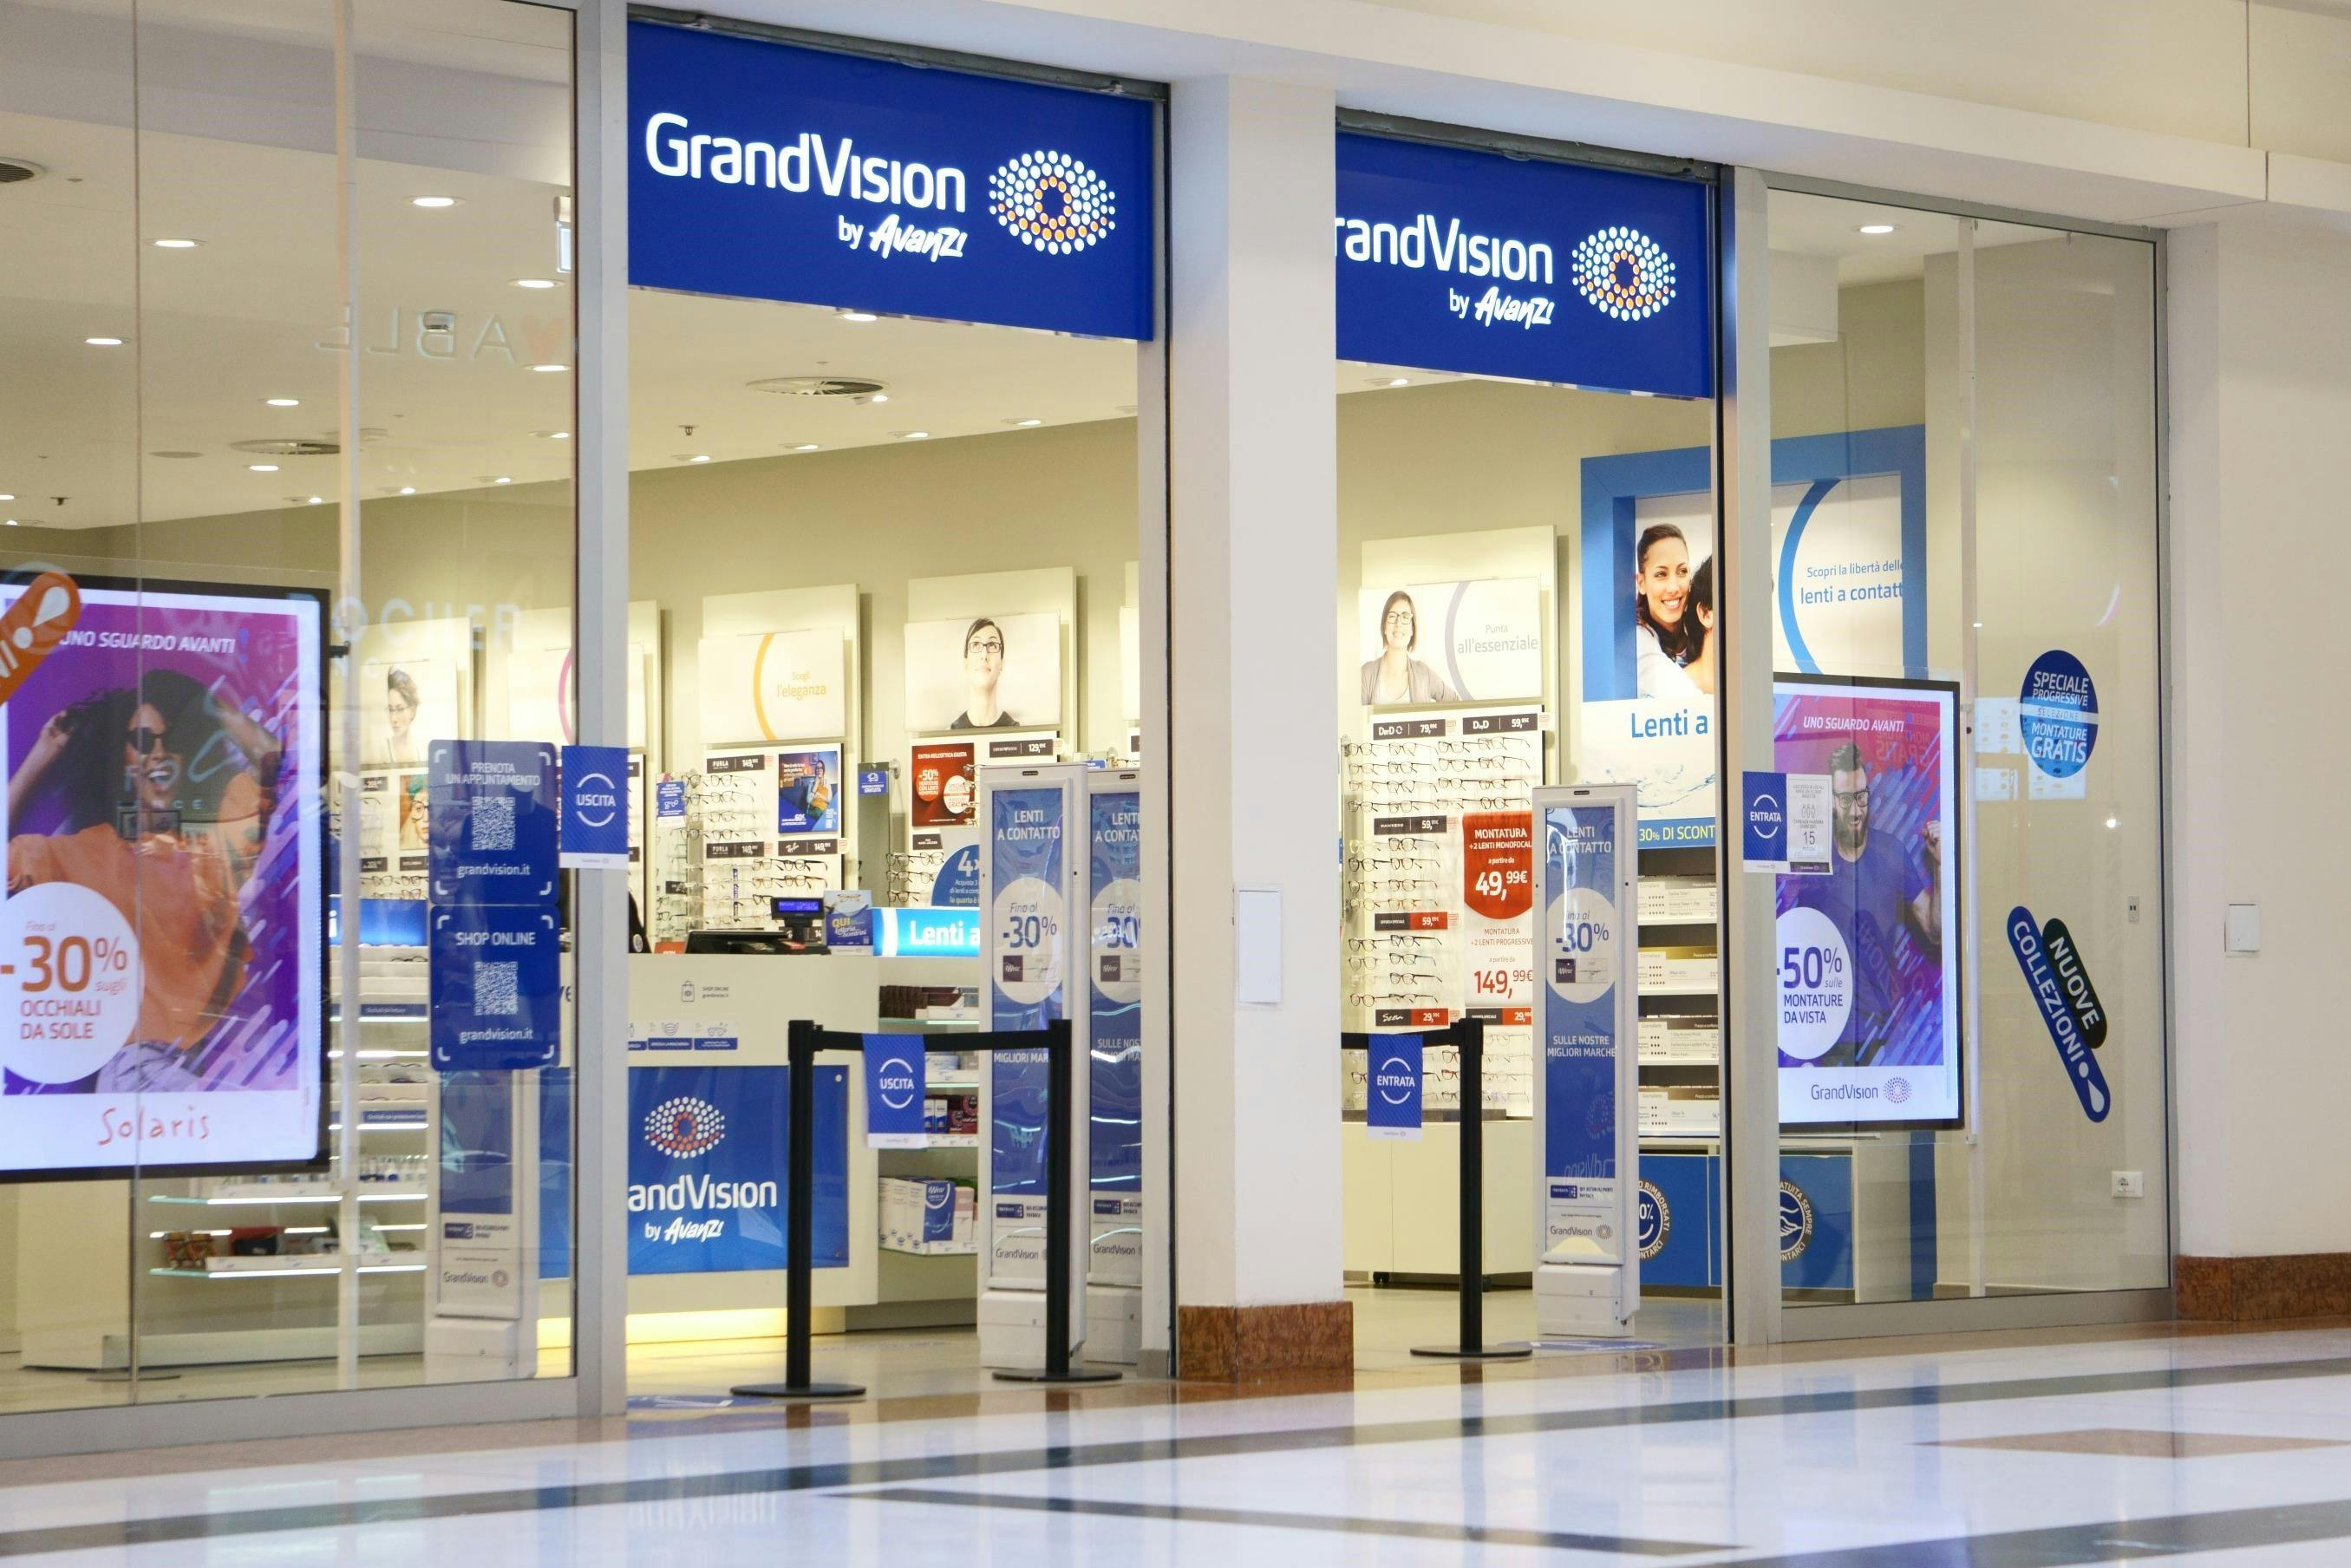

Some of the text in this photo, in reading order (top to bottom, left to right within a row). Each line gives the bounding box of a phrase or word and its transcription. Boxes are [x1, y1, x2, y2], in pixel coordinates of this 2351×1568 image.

[646, 112, 966, 212] GrandVision
[839, 215, 864, 250] by
[1335, 213, 1553, 284] randVision
[1450, 288, 1470, 318] by
[1806, 565, 1837, 580] Scopri
[1838, 564, 1847, 575] la
[1850, 561, 1879, 574] libertà
[1800, 582, 1903, 604] lenti a contatt
[1486, 624, 1508, 634] Punta
[59, 630, 236, 654] UNO SGUARDO AVANTI
[1457, 635, 1538, 655] all'essenziale
[2033, 671, 2089, 694] SPECIALE
[776, 684, 826, 702] l'eleganza
[2032, 688, 2088, 707] PROGRESSIVE
[2038, 707, 2080, 721] SELEZIONE
[1630, 709, 1708, 739] Lenti a
[1804, 715, 1904, 733] UNO SGUARDO AVANTI
[2032, 722, 2087, 742] MONTATURE
[2031, 737, 2087, 763] GRATIS
[471, 761, 515, 774] PRENOTA
[445, 773, 540, 787] UN APPUNTAMENTO
[576, 794, 617, 807] USCITA
[1015, 810, 1043, 823] LENTI
[1750, 811, 1781, 822] ENTRATA
[997, 826, 1060, 840] A CONTATTO
[1095, 829, 1140, 842] A CONTA
[1474, 828, 1527, 839] MONTATURA
[1567, 826, 1595, 839] LENTI
[1639, 825, 1715, 841] 30% DI SCONT
[1804, 831, 1816, 846] 15
[1496, 840, 1531, 849] MONOFOCAL
[1550, 844, 1557, 854] A
[1492, 857, 1508, 866] partire
[456, 863, 531, 879] grandvision.it
[1475, 870, 1527, 901] 49,99€
[1009, 901, 1038, 913] Fino al
[1563, 910, 1590, 921] ino al
[455, 932, 536, 946] SHOP ONLINE
[910, 920, 964, 945] Lenti
[1002, 915, 1057, 949] -30%
[1556, 921, 1610, 953] -30%
[0, 936, 127, 993] -30%
[1776, 947, 1842, 989] -50%
[1474, 970, 1533, 999] 149,99€
[1825, 977, 1843, 989] sulle
[2014, 920, 2085, 1062] COLLEZIONI
[2049, 937, 2100, 1030] NUOVE
[1784, 994, 1843, 1007] MONTATURE
[20, 1000, 101, 1018] OCCHIALI
[1784, 1011, 1826, 1024] DA VISTA
[20, 1022, 95, 1041] DA SOLE
[460, 1029, 532, 1044] grandvision.it
[1097, 1038, 1140, 1049] SULLE NOS
[1553, 1036, 1610, 1046] SULLE NOSTRE
[994, 1052, 1049, 1062] MIGLIORI MAR
[1547, 1047, 1616, 1057] MIGLIORI MARCHE
[879, 1078, 914, 1090] USCITA
[1376, 1075, 1415, 1088] ENTRATA
[1811, 1084, 1878, 1101] GrandVision
[98, 1107, 210, 1146] Solaris
[628, 1174, 778, 1212] andVision
[1639, 1203, 1654, 1219] 0%
[1645, 1182, 1670, 1232] RIMBORSATI
[1780, 1182, 1812, 1236] ATUITA SEMPRE
[645, 1223, 660, 1241] by
[1551, 1225, 1593, 1236] GrandVision
[996, 1248, 1038, 1259] GrandVision
[1094, 1244, 1135, 1255] GrandVision
[1639, 1241, 1663, 1260] NTARCI
[1780, 1242, 1806, 1262] NTARCI
